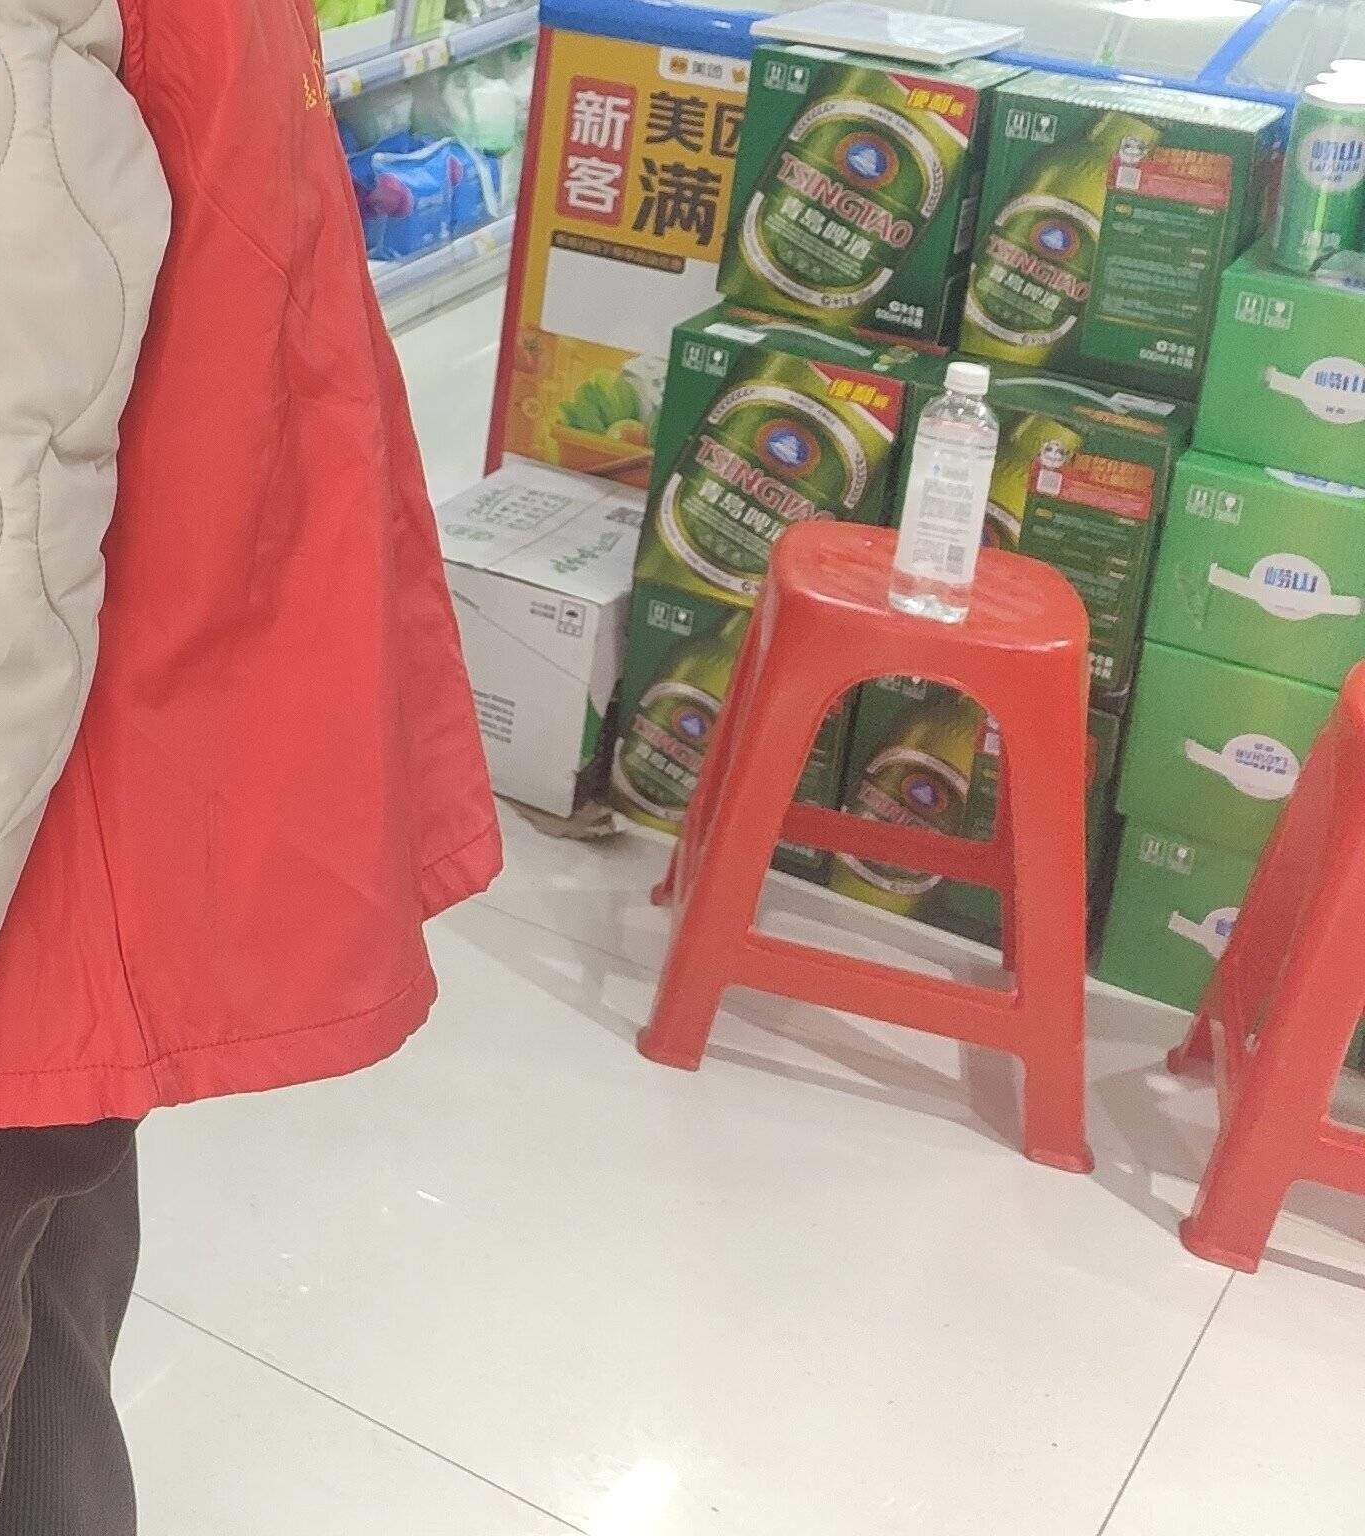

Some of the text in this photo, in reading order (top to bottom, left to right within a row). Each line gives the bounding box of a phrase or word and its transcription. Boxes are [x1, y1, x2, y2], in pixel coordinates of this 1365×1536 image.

[564, 89, 632, 215] 新客
[776, 151, 913, 250] TSINGTAO
[780, 196, 873, 260] 青岛啤酒
[986, 233, 1091, 303] TSINGTAO
